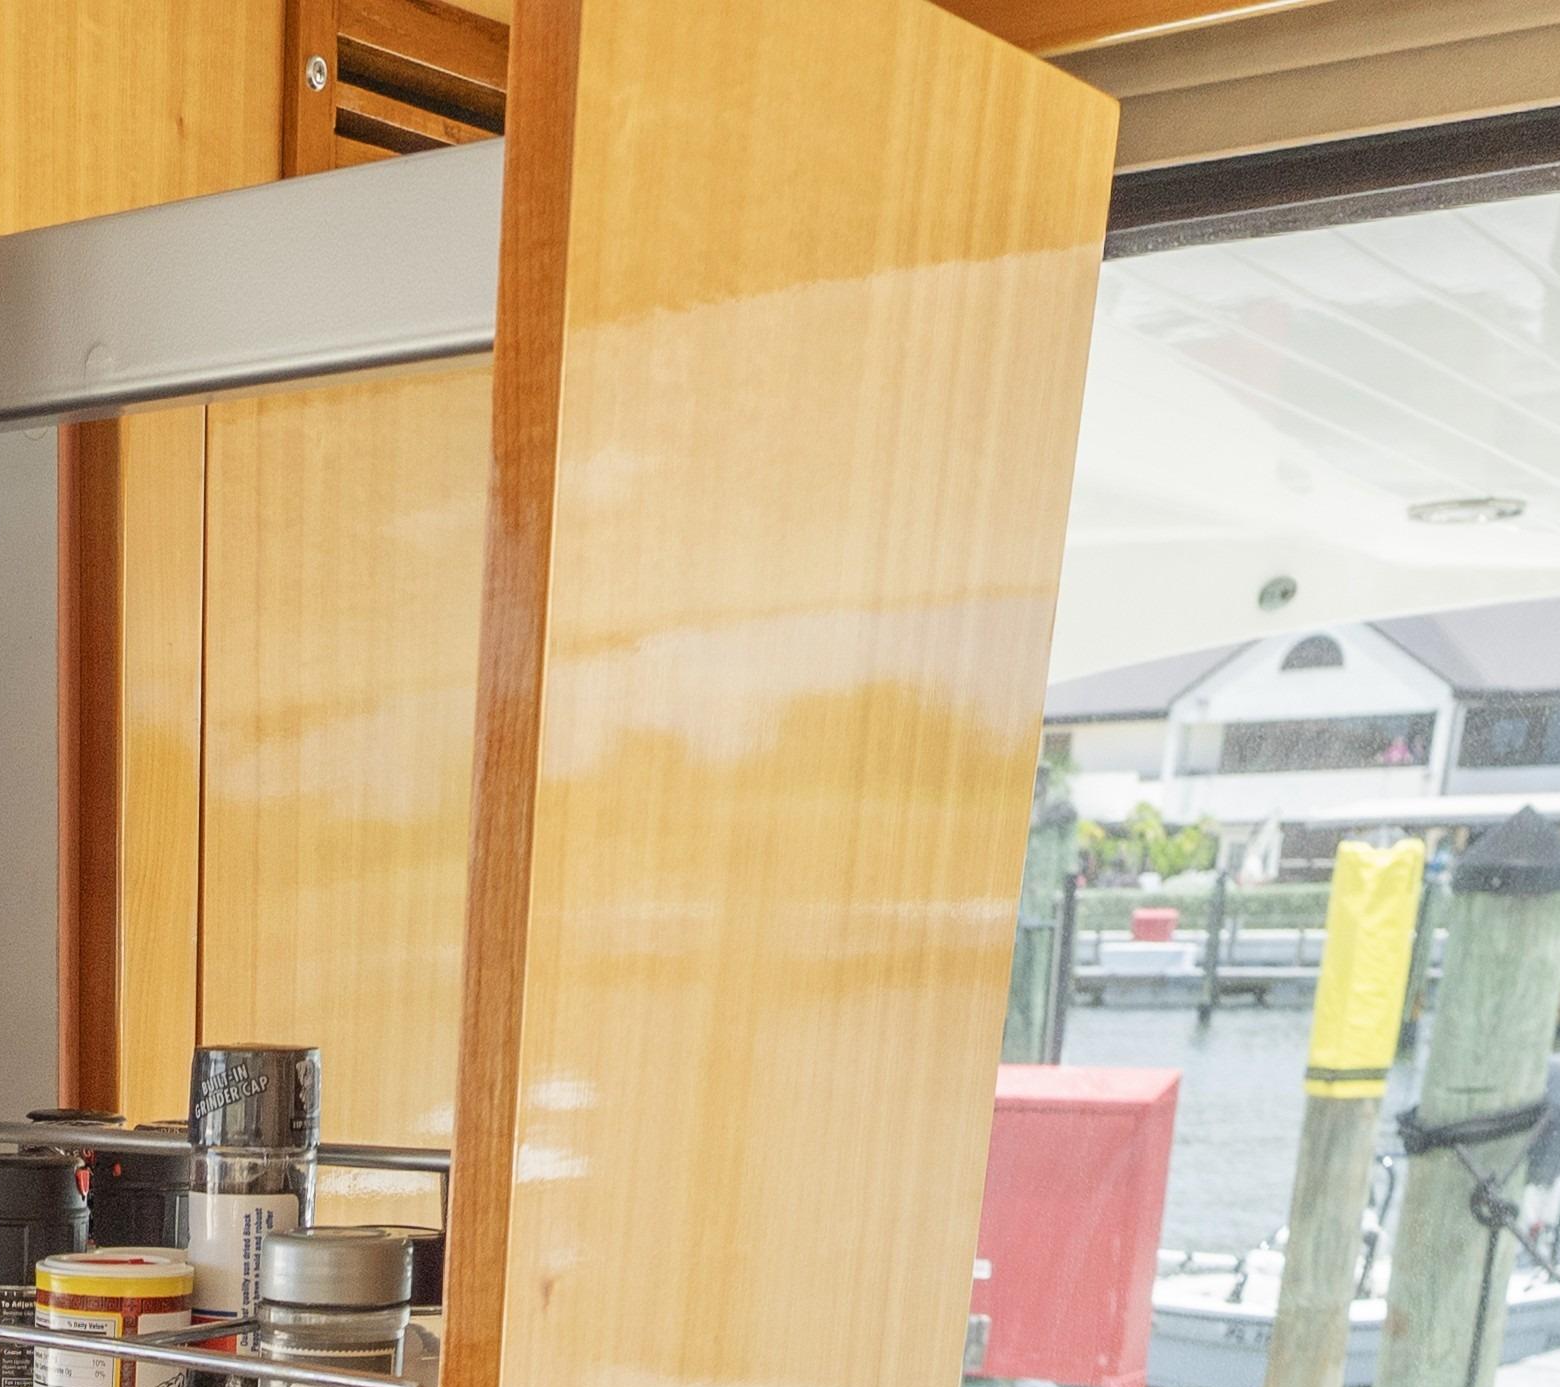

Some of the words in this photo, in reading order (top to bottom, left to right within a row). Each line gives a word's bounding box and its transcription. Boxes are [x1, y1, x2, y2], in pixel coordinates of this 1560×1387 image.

[194, 1085, 241, 1120] GRINDER
[242, 1076, 270, 1097] CAP
[201, 1064, 249, 1097] BUILT-IN
